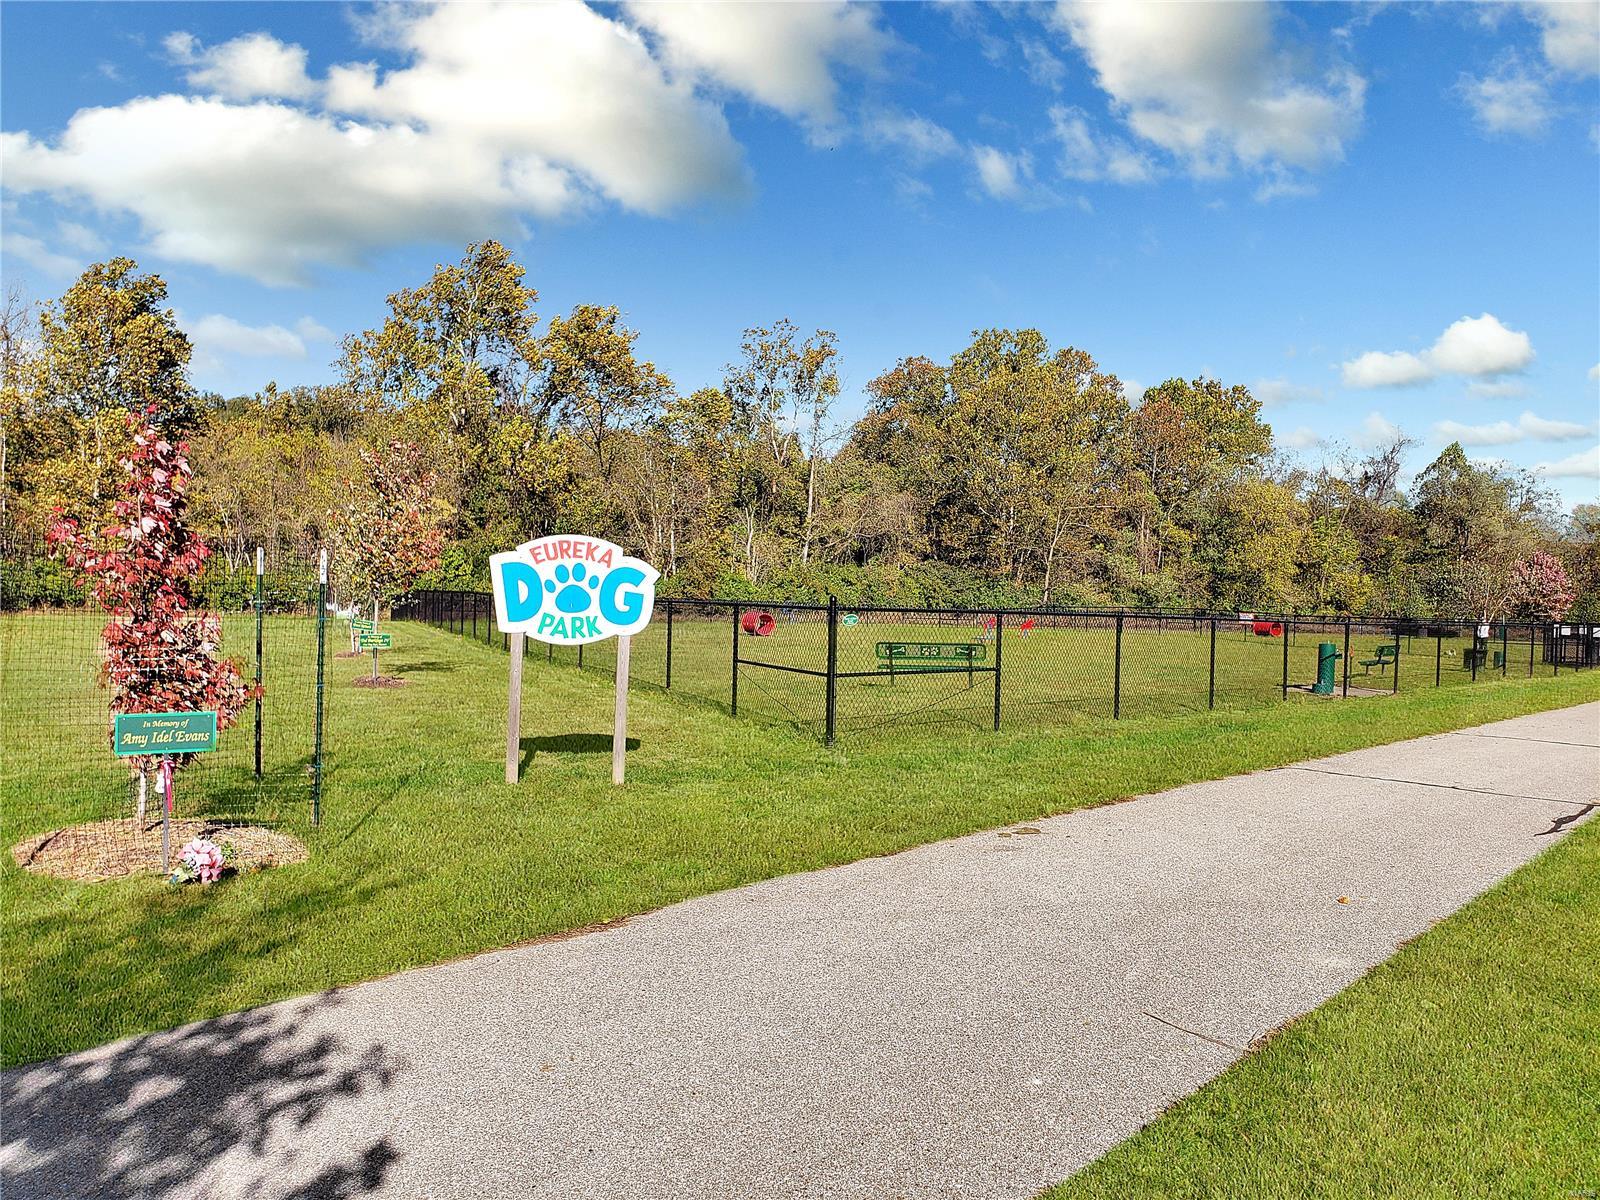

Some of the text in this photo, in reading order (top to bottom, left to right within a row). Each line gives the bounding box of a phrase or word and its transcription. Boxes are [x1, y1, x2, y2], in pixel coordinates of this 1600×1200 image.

[529, 540, 613, 568] EUREKA
[501, 562, 646, 626] DG
[537, 612, 602, 639] PARK
[152, 720, 180, 728] Memory
[181, 719, 189, 727] of
[121, 730, 210, 747] Amy Idel Evans
